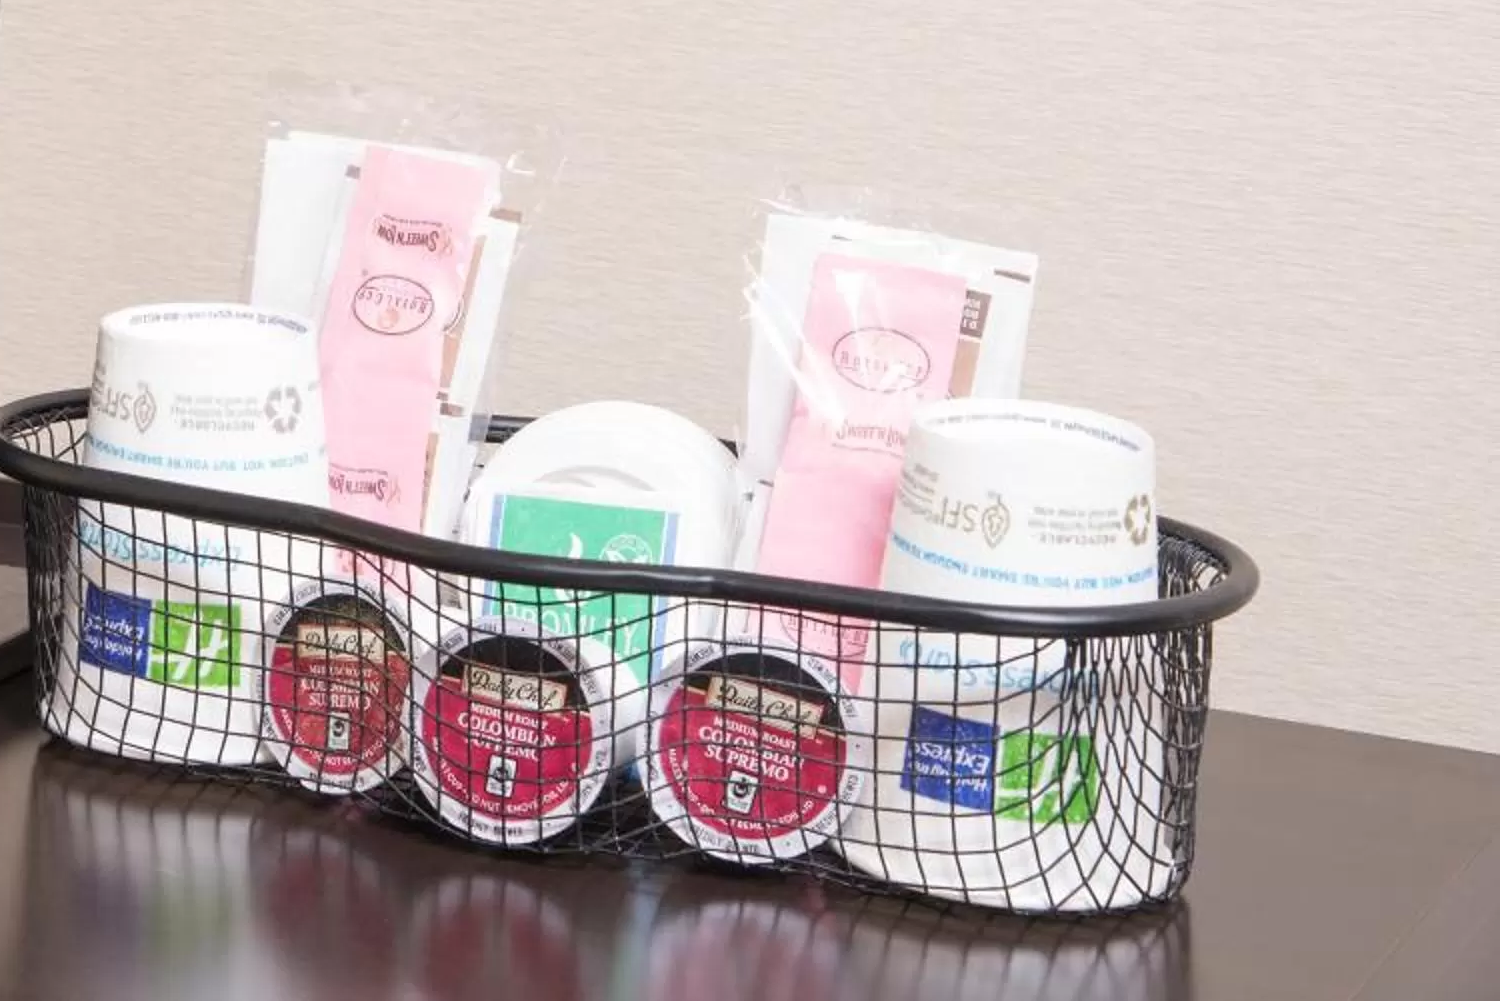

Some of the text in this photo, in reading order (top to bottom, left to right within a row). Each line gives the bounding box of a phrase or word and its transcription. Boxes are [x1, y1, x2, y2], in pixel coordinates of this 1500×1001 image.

[516, 682, 559, 711] Chf
[761, 730, 797, 751] ROAST
[703, 744, 790, 782] SUPREMO
